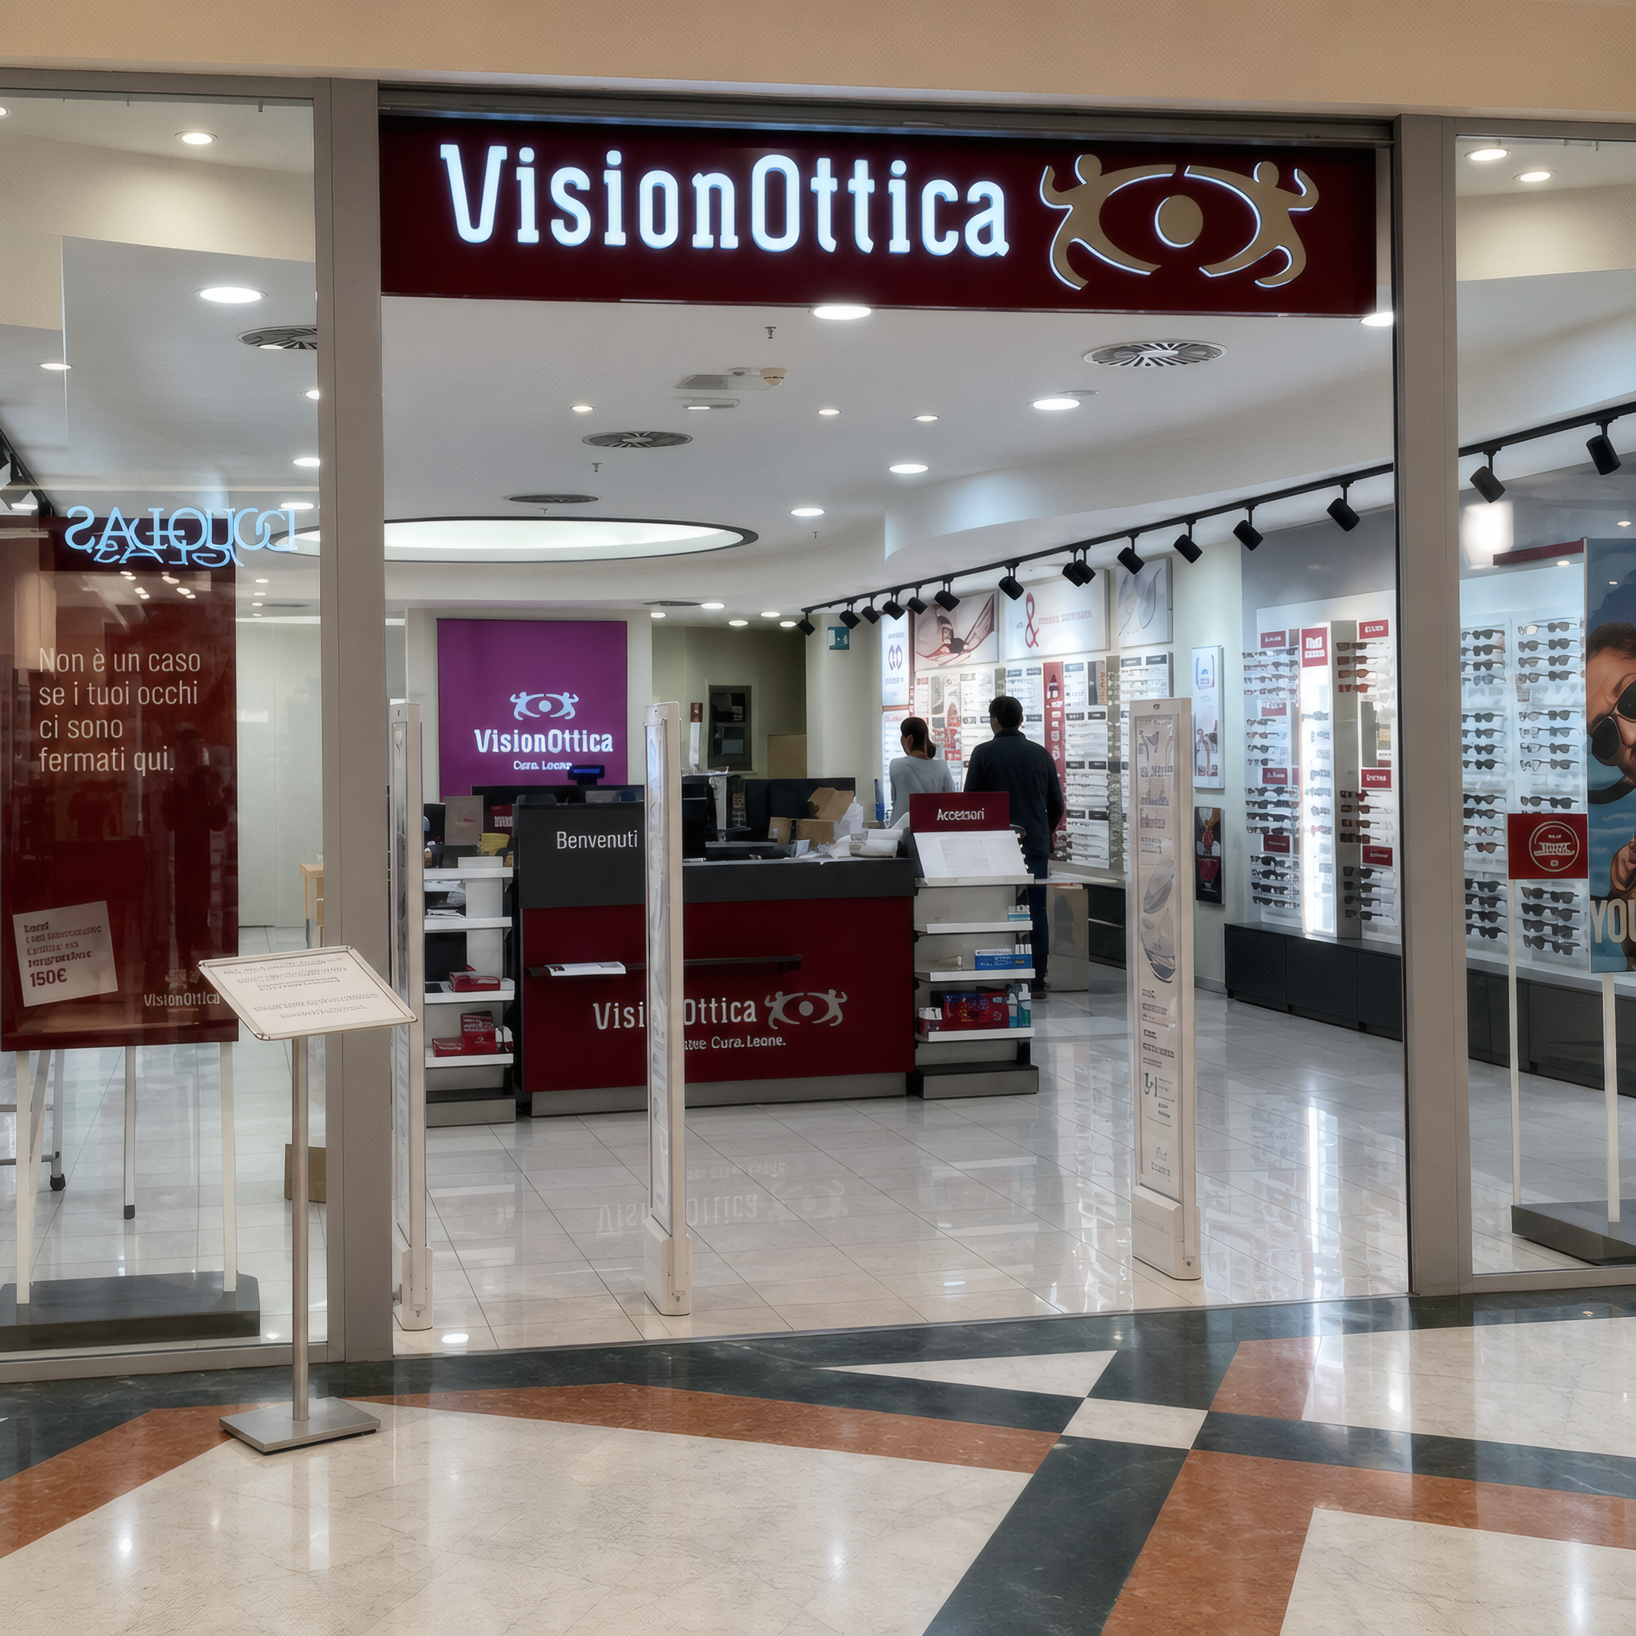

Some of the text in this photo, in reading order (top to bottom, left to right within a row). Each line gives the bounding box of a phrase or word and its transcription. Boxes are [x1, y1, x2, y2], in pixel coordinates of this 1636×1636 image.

[439, 142, 1010, 257] VisionOttica
[38, 647, 201, 673] Non è un caso
[39, 680, 198, 706] se i tuoi occhi
[39, 715, 123, 739] ci sono
[473, 728, 614, 754] VisionOttica
[39, 746, 175, 776] fermati qui.
[556, 829, 639, 850] Benvenuti
[30, 967, 67, 988] 150€
[711, 1035, 745, 1050] Cura.
[747, 1034, 787, 1049] Leone.
